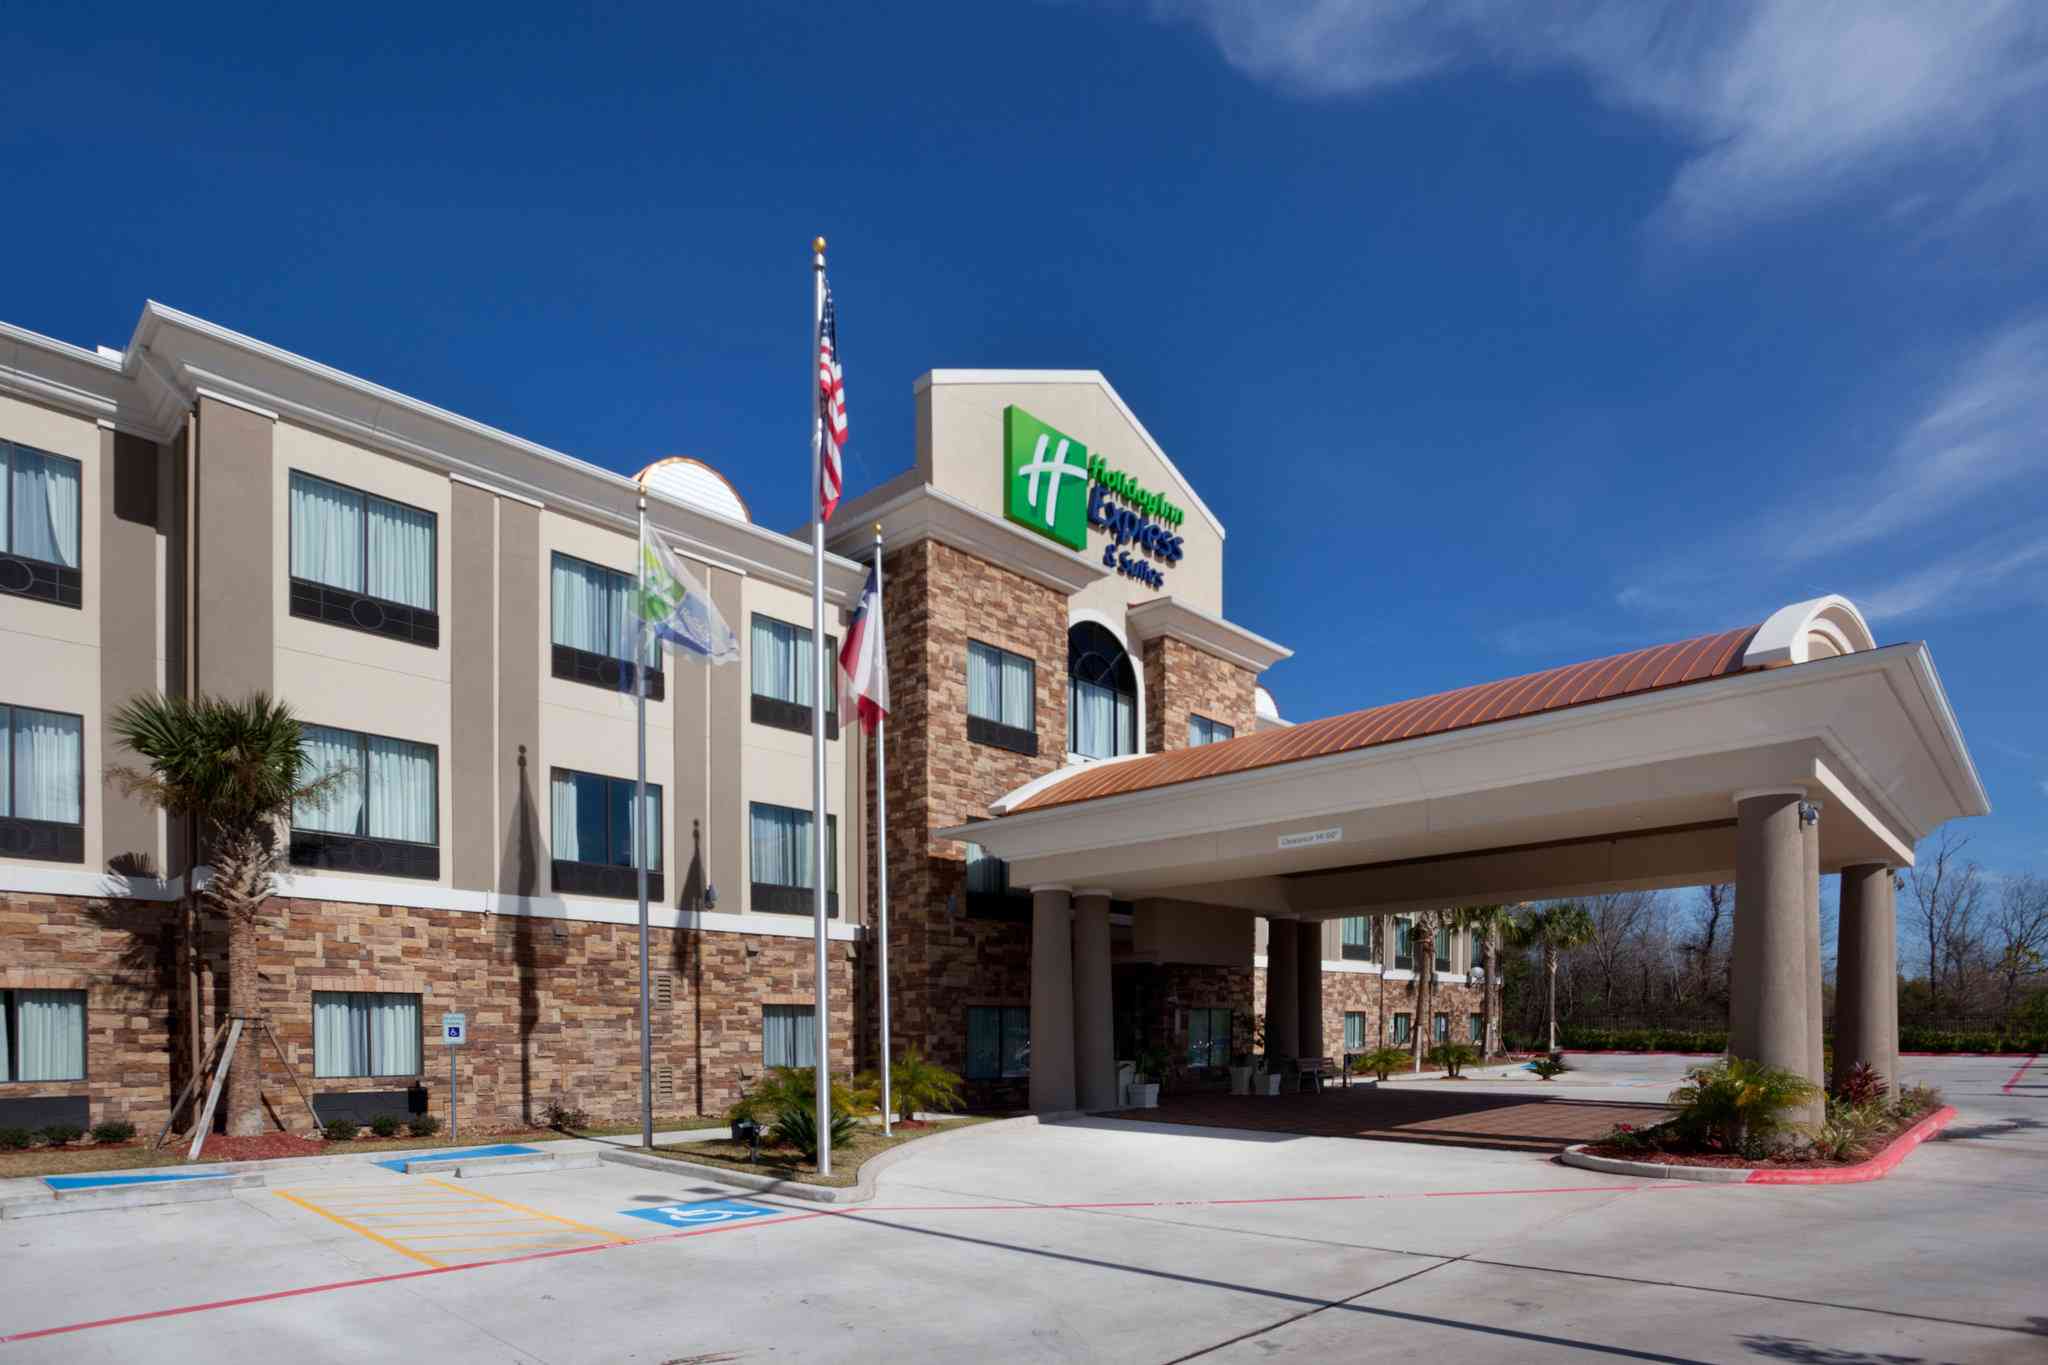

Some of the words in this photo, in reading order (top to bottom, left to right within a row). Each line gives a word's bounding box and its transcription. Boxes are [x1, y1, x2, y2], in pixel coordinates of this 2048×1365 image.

[1088, 453, 1158, 514] Holiday
[1087, 484, 1184, 562] Express
[1118, 551, 1164, 588] Suites
